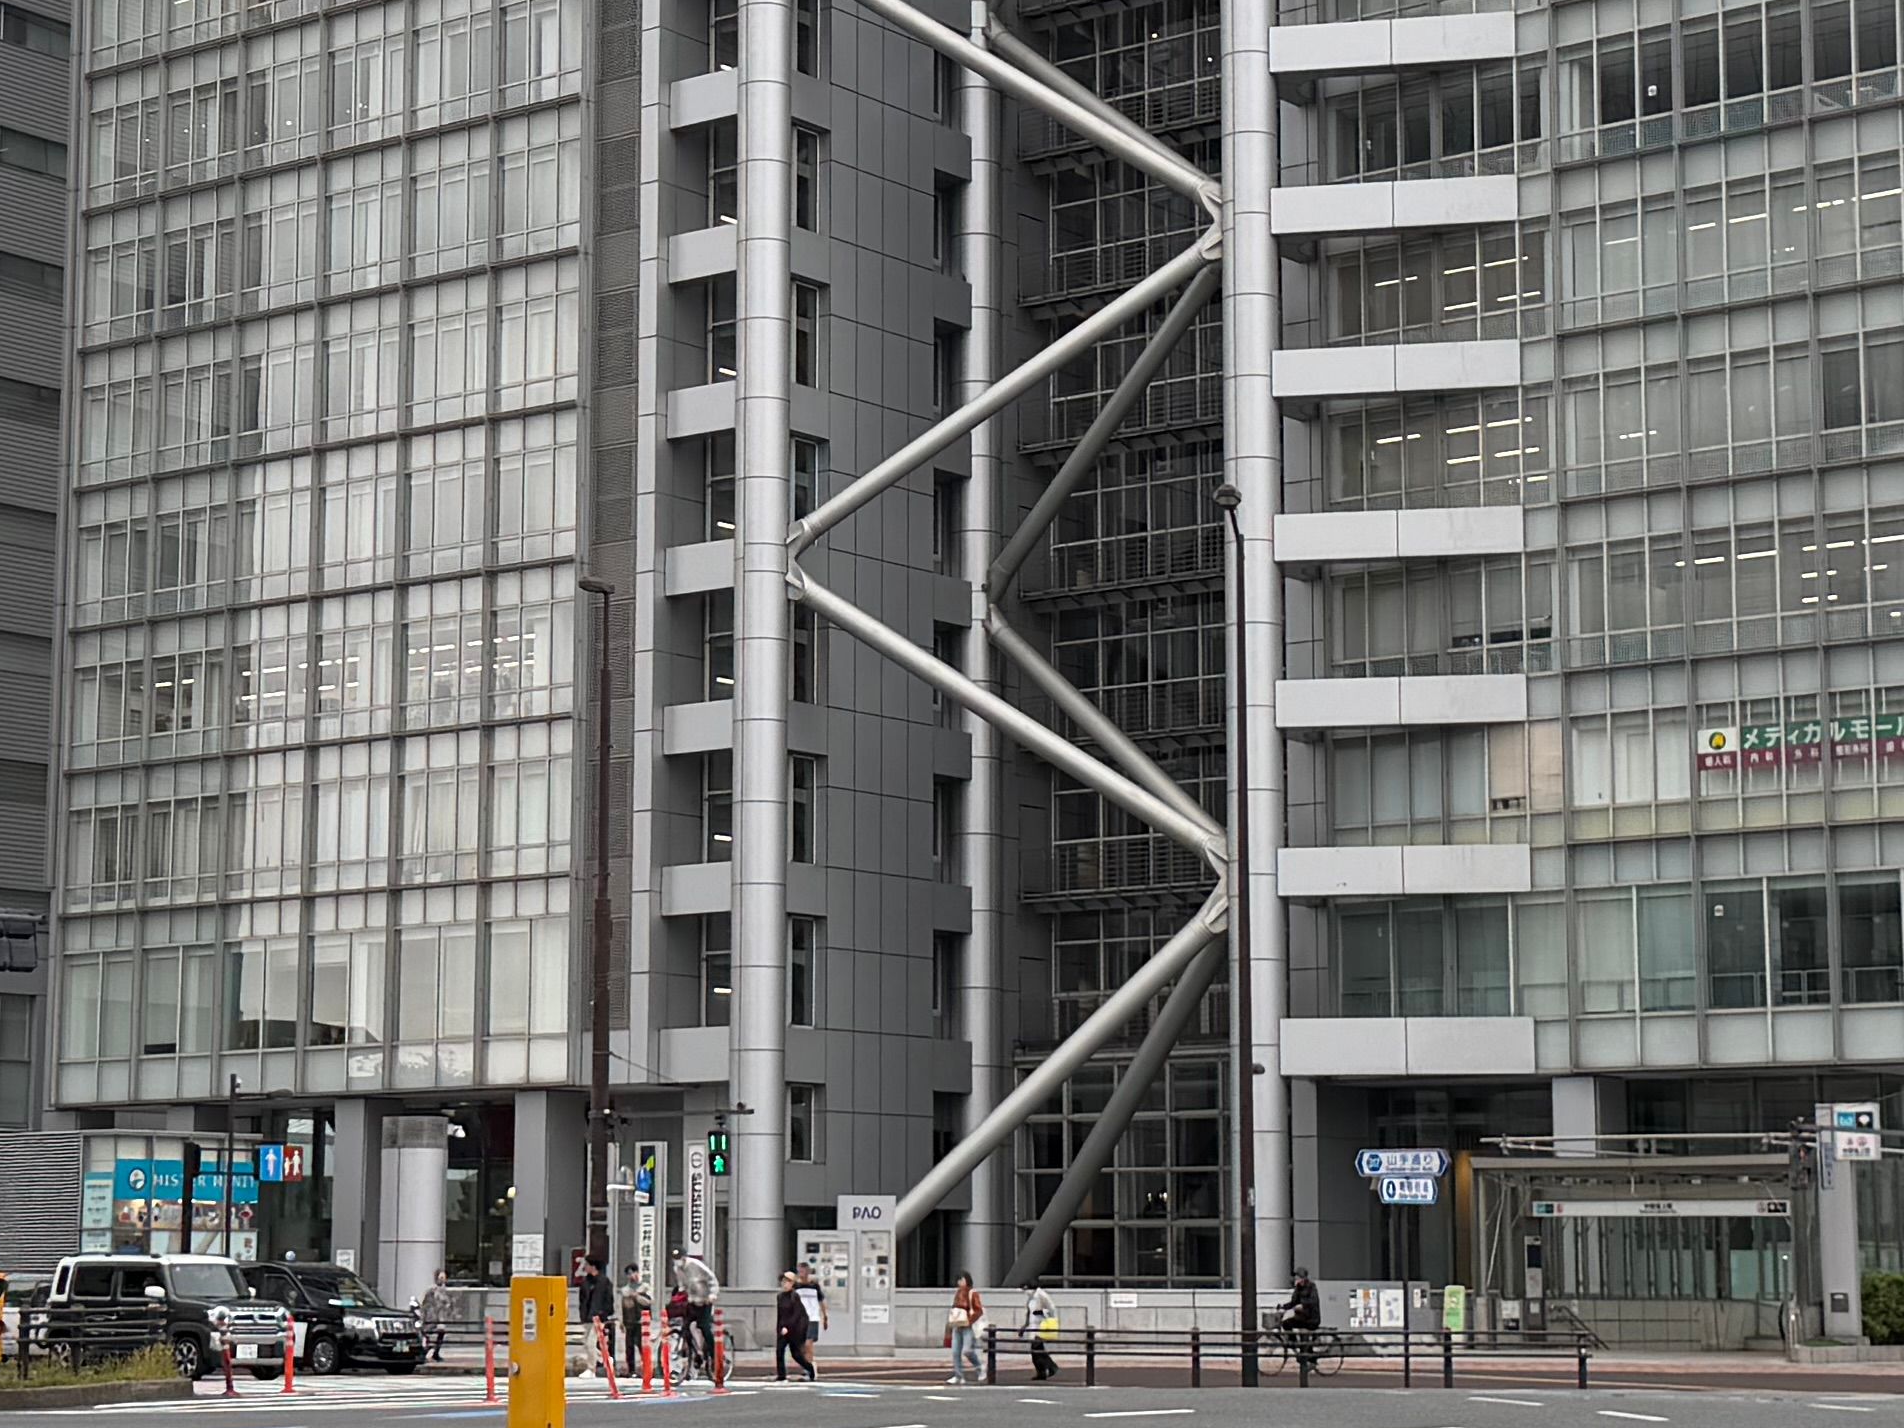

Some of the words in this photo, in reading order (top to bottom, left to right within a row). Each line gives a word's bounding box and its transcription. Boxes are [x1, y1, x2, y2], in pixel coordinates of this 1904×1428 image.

[154, 1173, 206, 1187] MISR
[213, 1175, 256, 1188] MNIT
[691, 1173, 702, 1244] SUSHIRO
[852, 1206, 881, 1220] PAO
